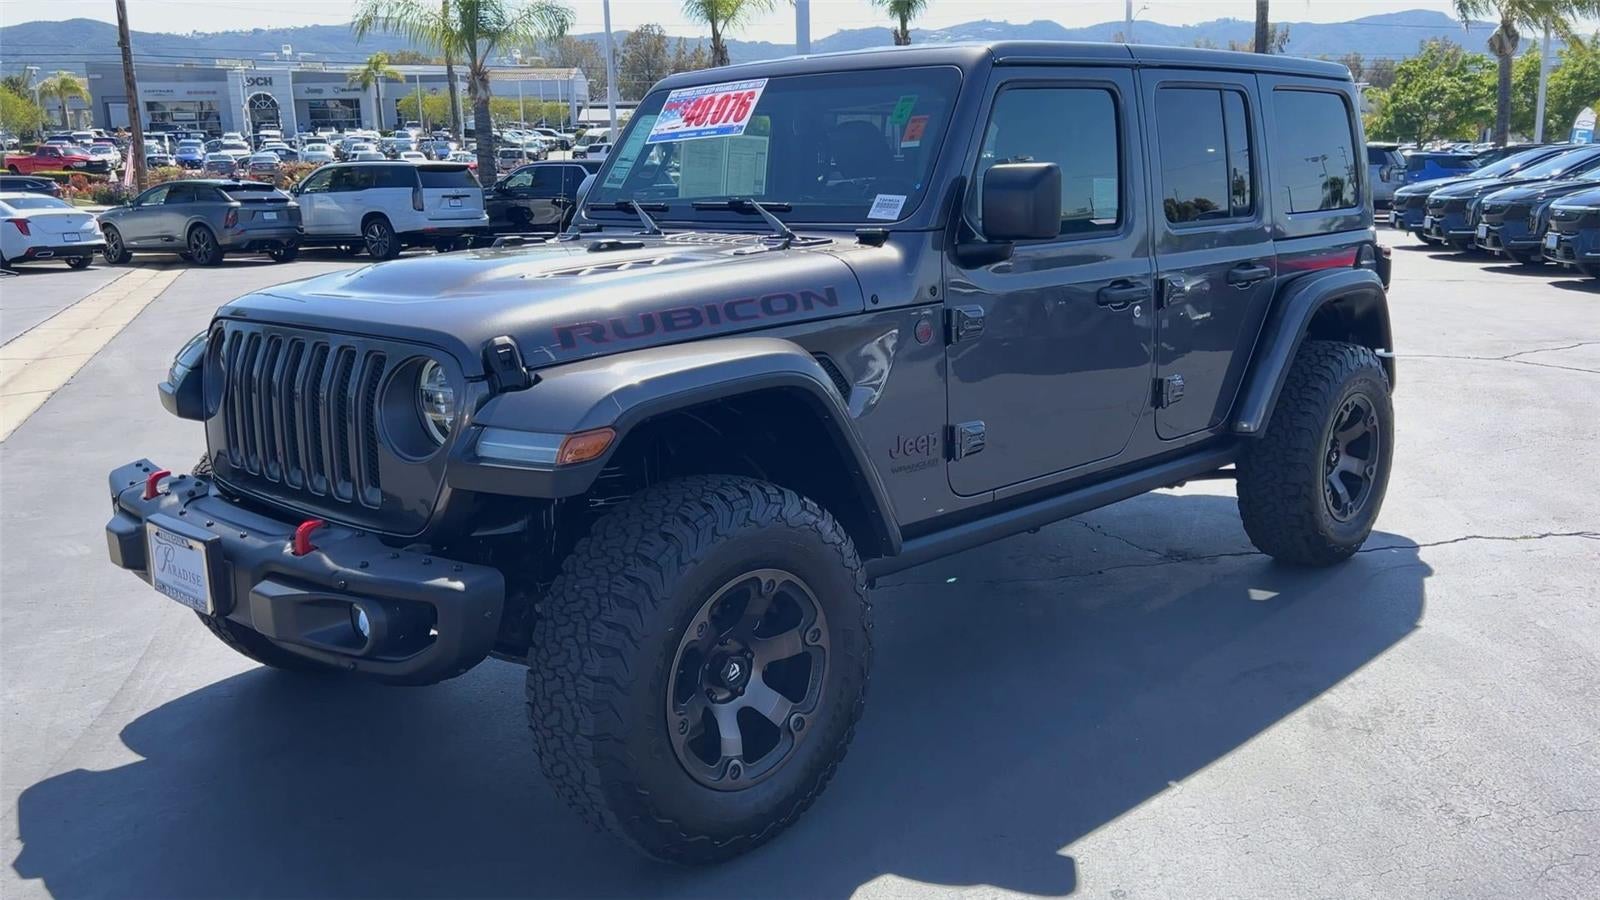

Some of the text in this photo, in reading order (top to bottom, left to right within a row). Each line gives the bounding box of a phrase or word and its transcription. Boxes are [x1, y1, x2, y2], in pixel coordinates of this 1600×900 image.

[553, 285, 839, 350] RUBICON
[889, 433, 938, 459] Jeep
[154, 537, 204, 588] PARADISE
